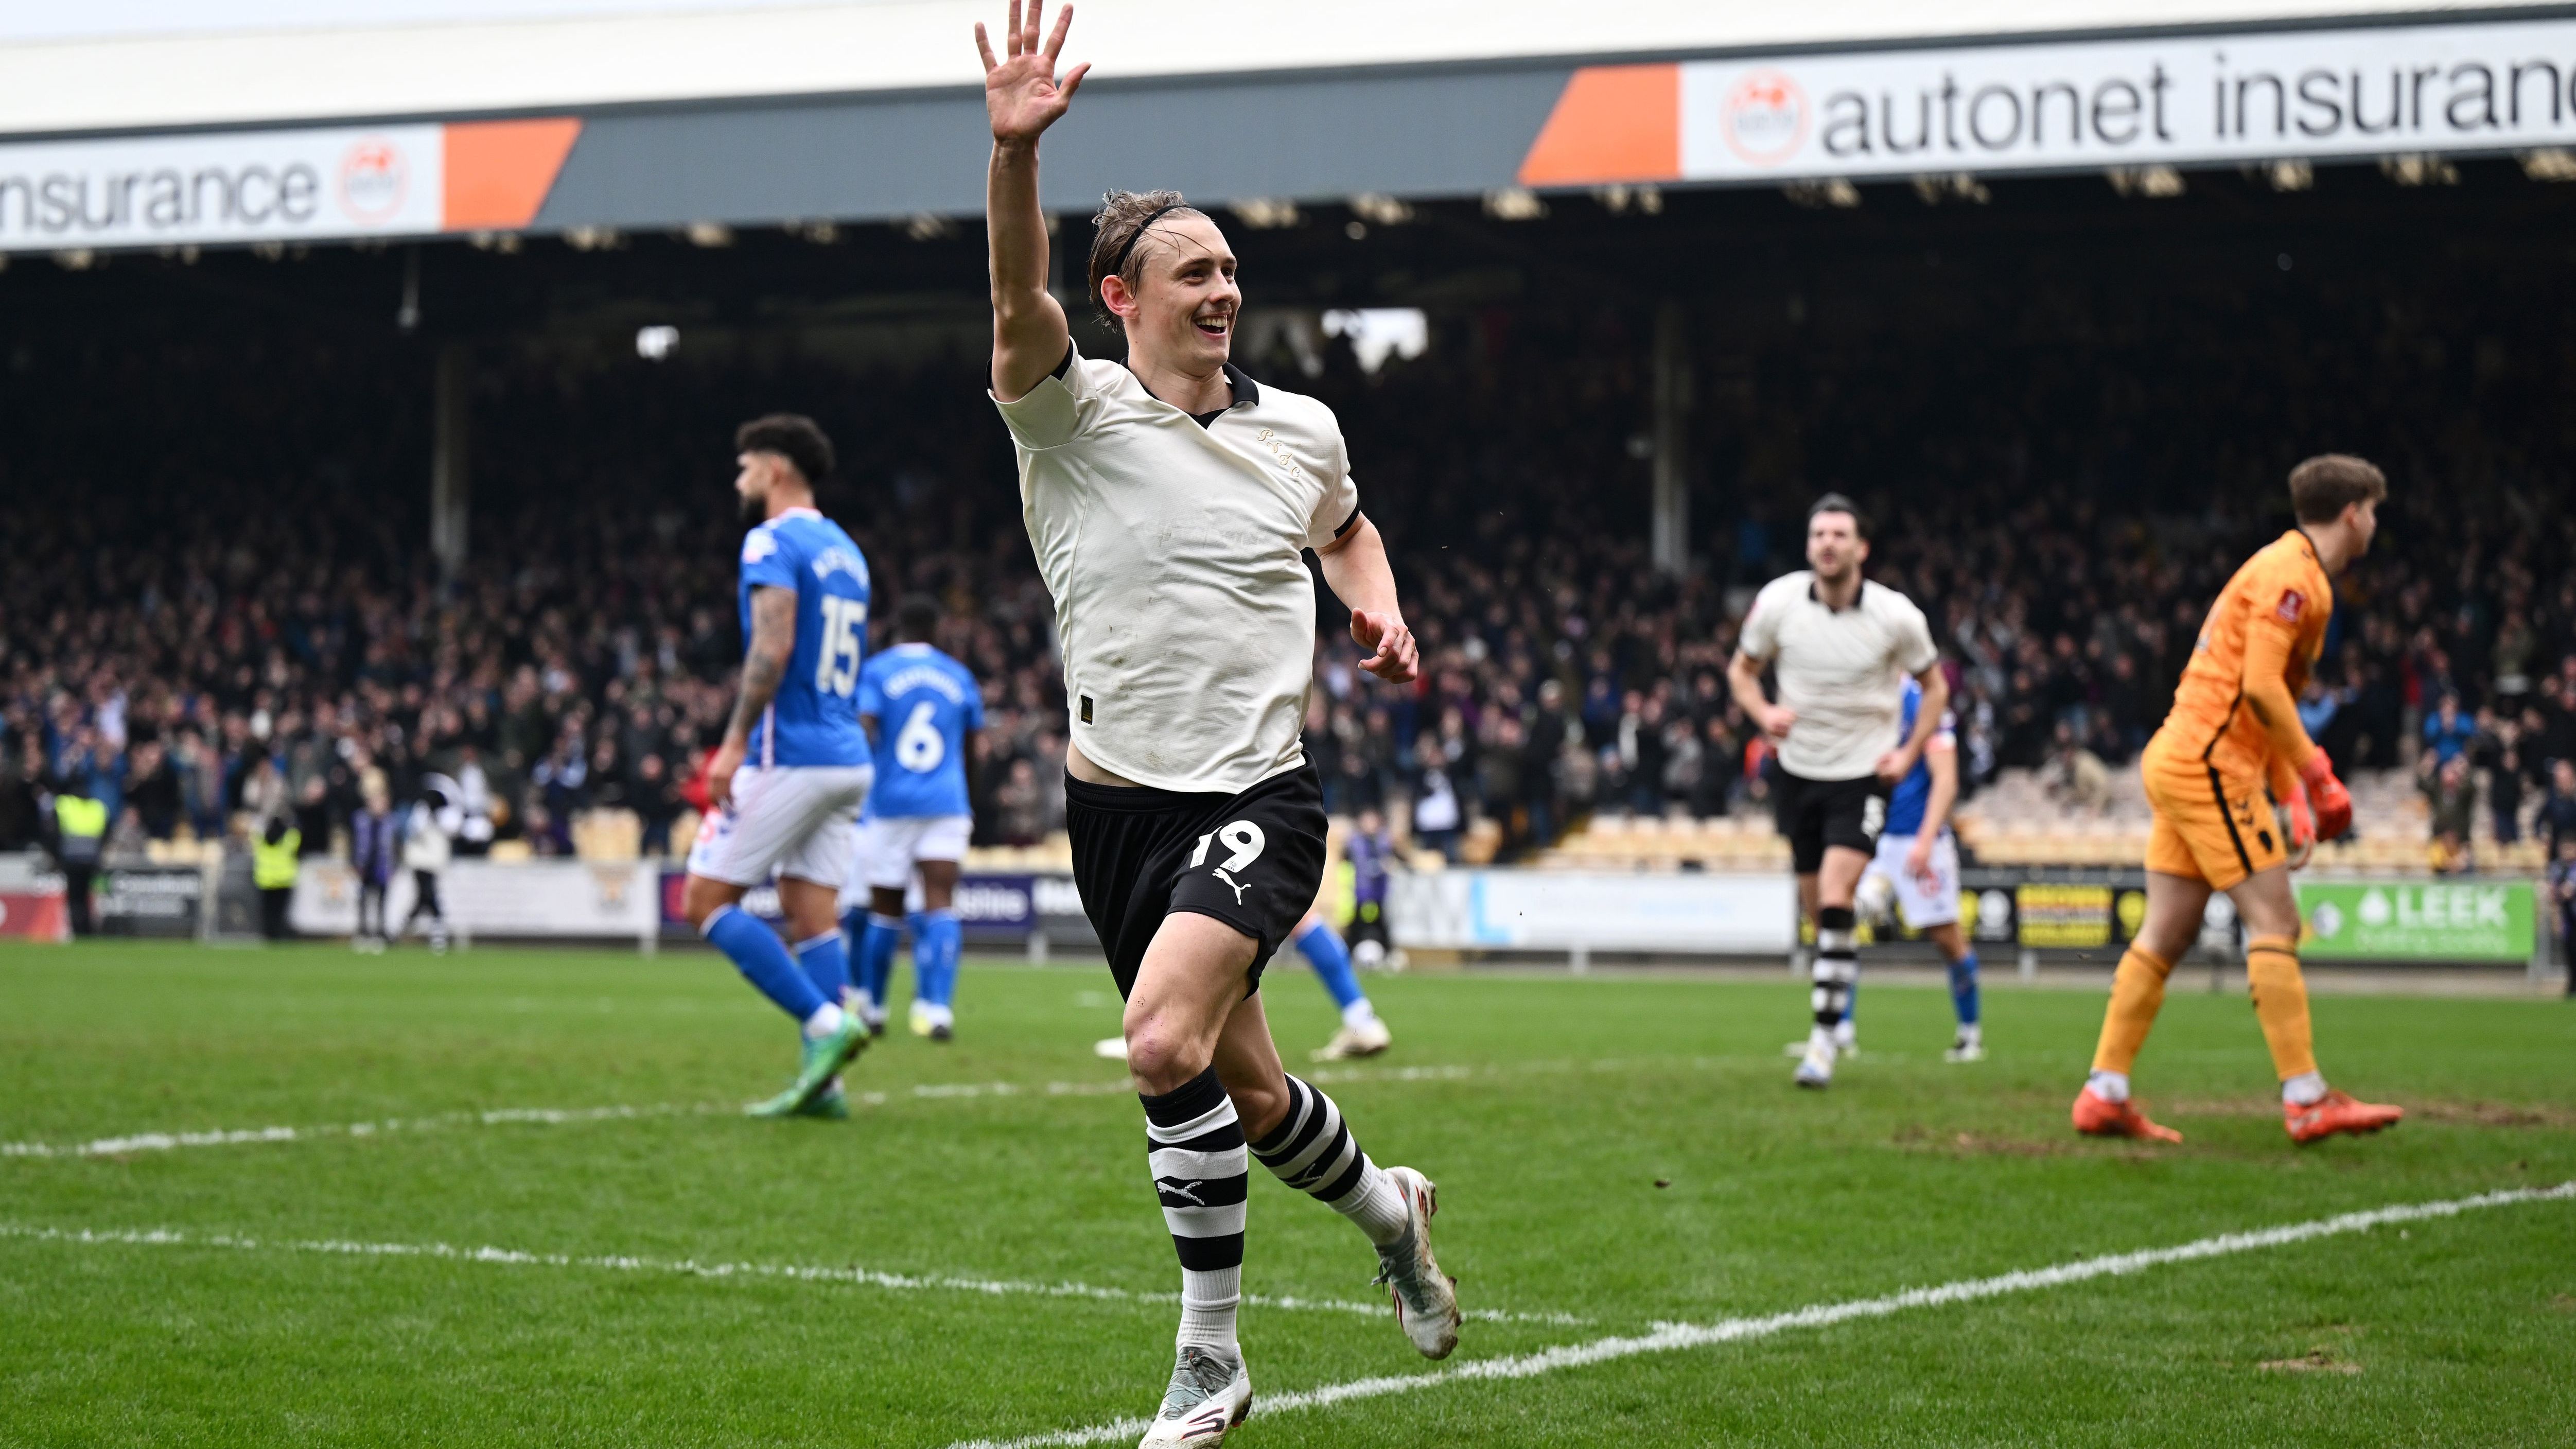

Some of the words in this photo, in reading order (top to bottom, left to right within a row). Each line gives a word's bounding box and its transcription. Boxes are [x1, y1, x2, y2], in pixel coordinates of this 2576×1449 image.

[1821, 61, 2175, 155] autonet
[2213, 50, 2576, 139] insuran
[0, 161, 319, 235] nsurance
[815, 594, 868, 699] 15
[895, 700, 945, 774] 6
[1189, 820, 1265, 873] 19
[2395, 884, 2509, 928] LEEK
